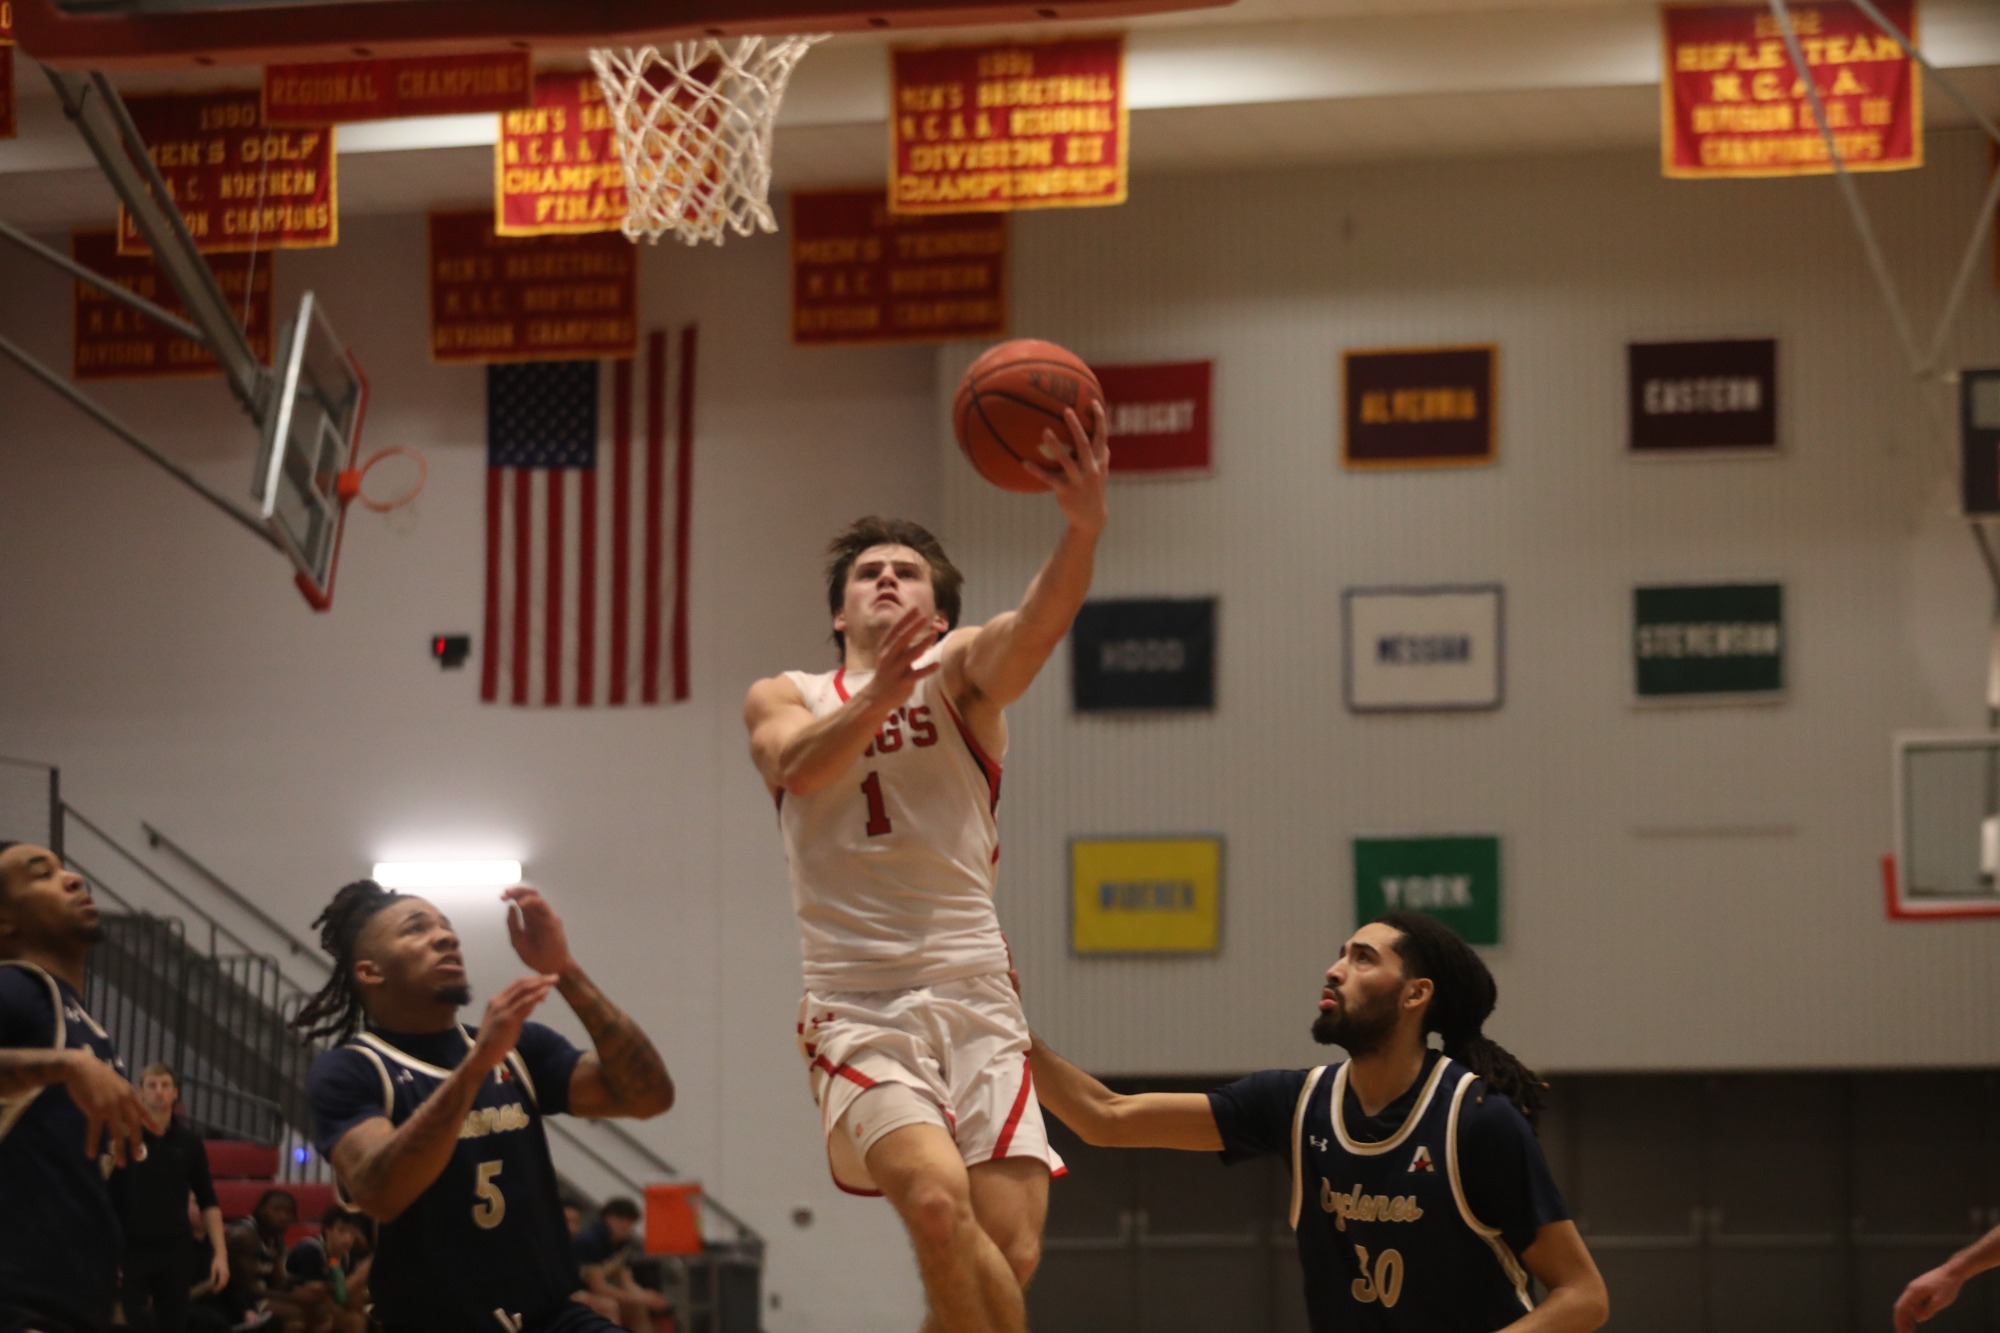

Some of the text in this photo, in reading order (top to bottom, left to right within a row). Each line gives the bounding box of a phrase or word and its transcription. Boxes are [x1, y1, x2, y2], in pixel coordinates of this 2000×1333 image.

[1677, 35, 1906, 71] RIFLE TEAM
[272, 64, 525, 106] REGIONAL CHAMPIONS
[978, 75, 1115, 108] BASKETBALL
[508, 106, 568, 136] MEN'S
[241, 134, 319, 163] GOLF
[911, 140, 1053, 172] DIVISION
[220, 171, 317, 200] NORTHERN
[224, 203, 329, 235] CHAMPIONS
[1644, 377, 1762, 414] EASTERN
[864, 705, 938, 757] G'S
[860, 770, 892, 837] 1
[1382, 874, 1473, 909] YORK
[472, 1159, 505, 1230] 5
[1320, 1176, 1424, 1232] Cyclones
